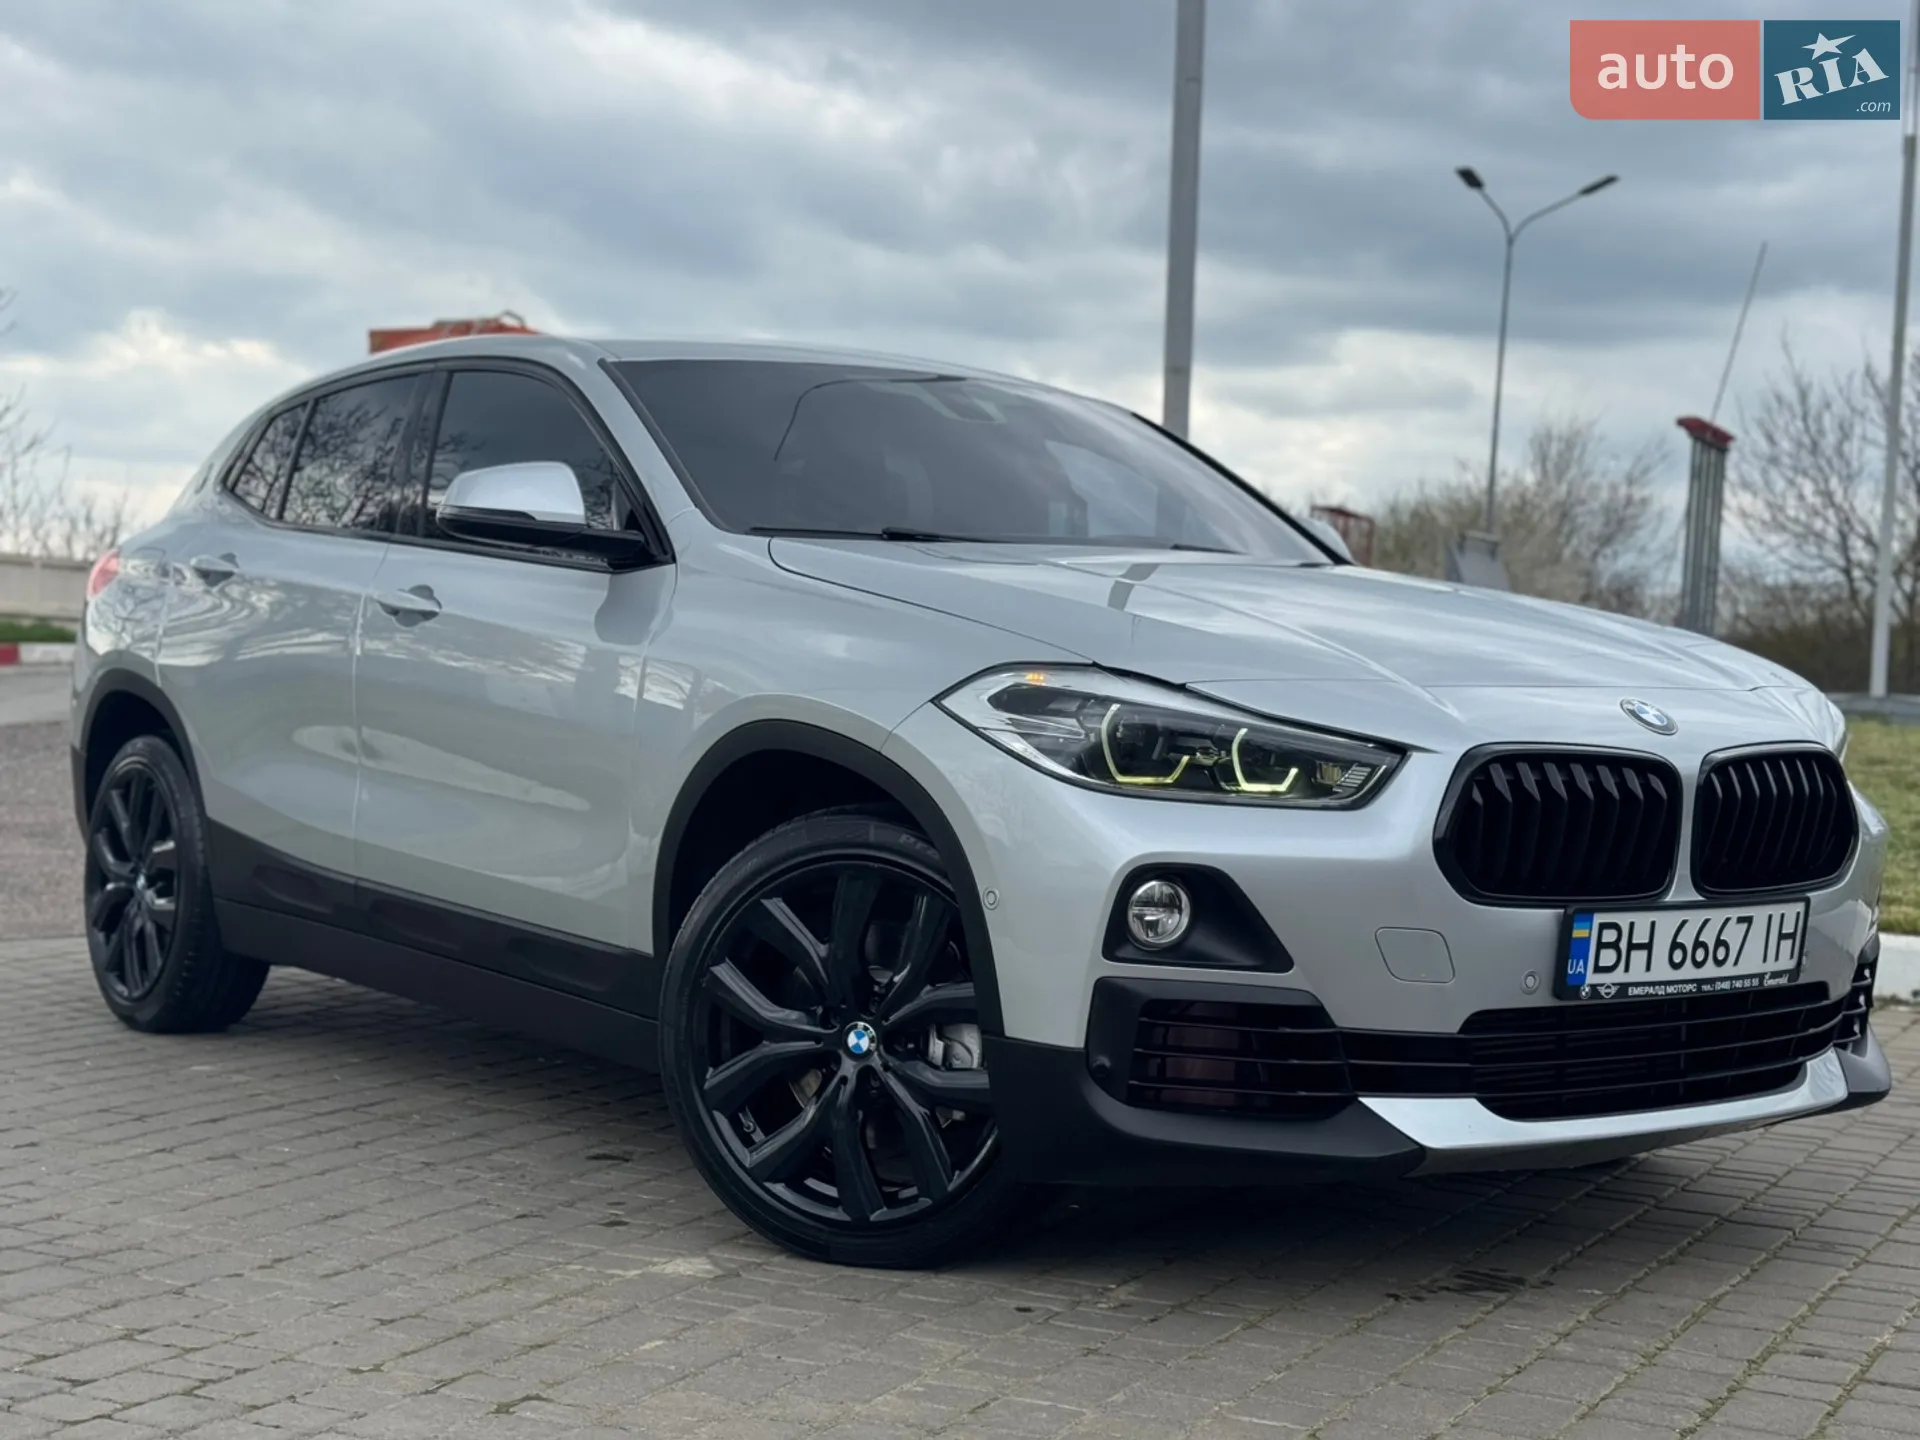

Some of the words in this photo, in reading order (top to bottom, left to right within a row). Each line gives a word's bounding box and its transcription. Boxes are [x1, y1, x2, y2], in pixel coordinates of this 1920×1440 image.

[1592, 920, 1657, 974] BH
[1668, 915, 1754, 970] 6667
[1762, 910, 1801, 964] IH
[1567, 959, 1585, 975] UA
[1628, 985, 1665, 996] ЕМЕРАЛД
[1666, 983, 1697, 994] МОТОРС
